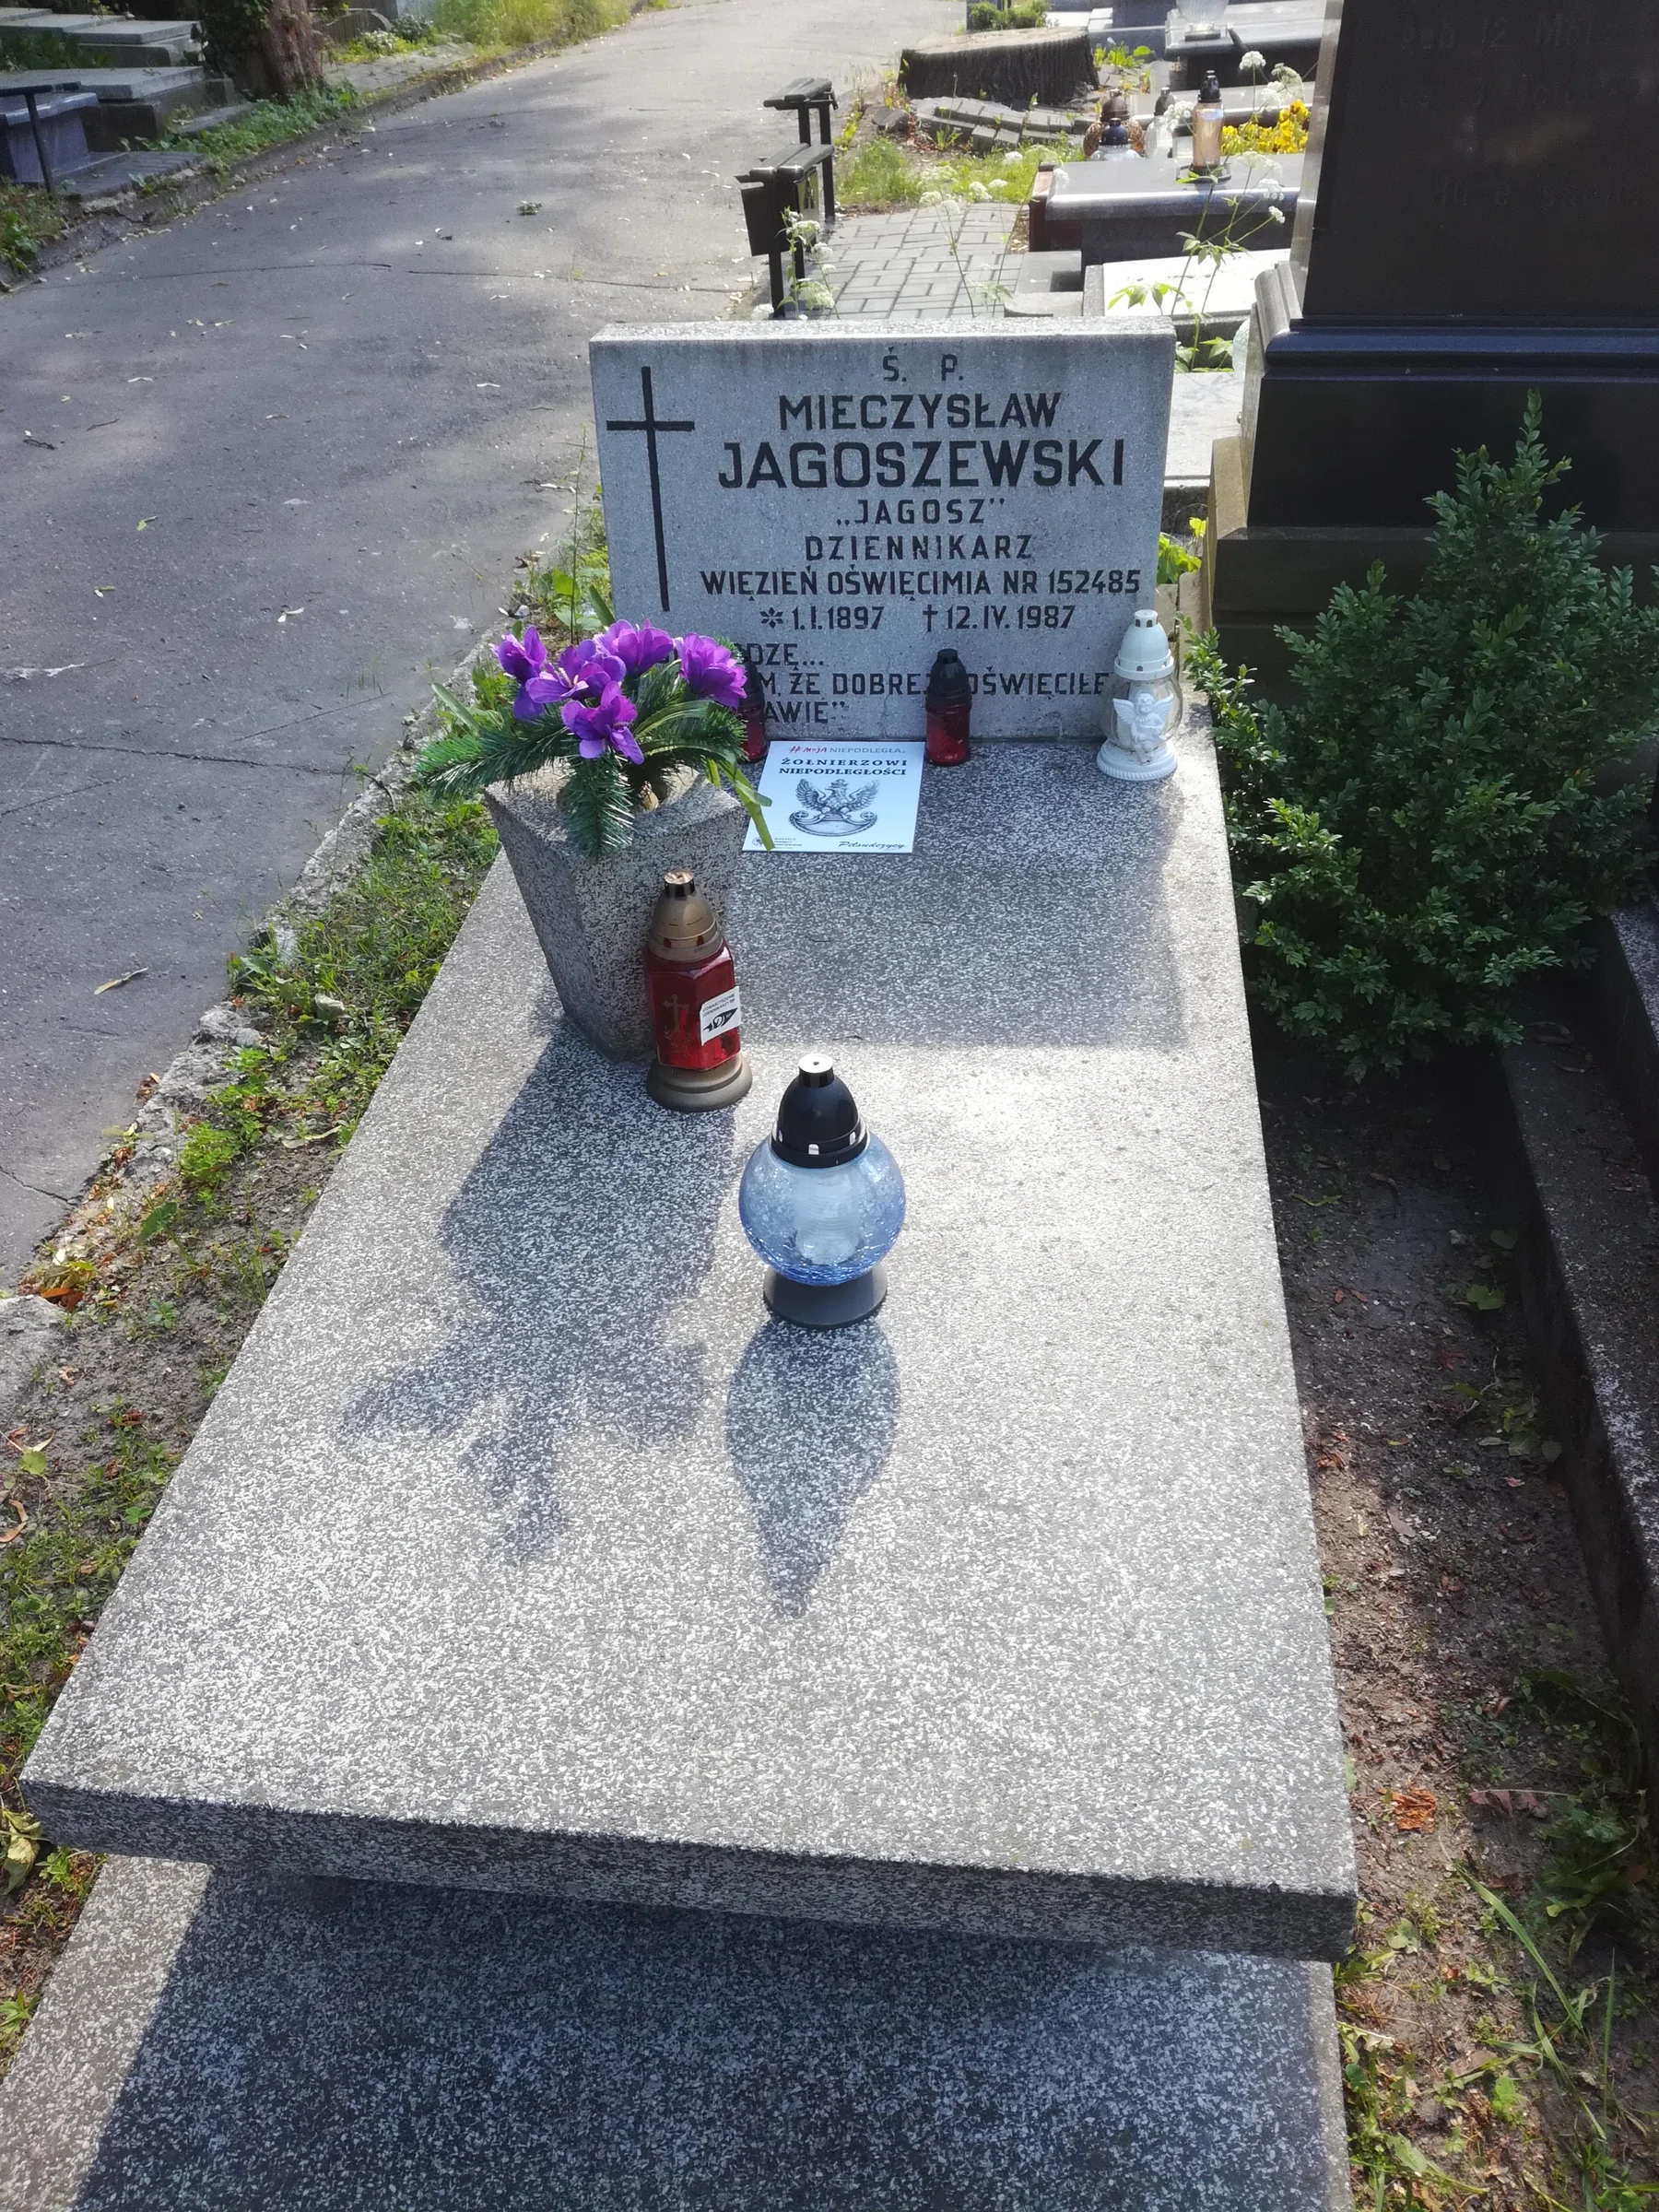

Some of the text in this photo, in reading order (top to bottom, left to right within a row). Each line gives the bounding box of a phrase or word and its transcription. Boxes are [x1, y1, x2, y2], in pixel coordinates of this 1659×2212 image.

[882, 347, 964, 382] Ś. P.
[779, 392, 1061, 431] MIECZYSŁAW
[717, 438, 1124, 489] JAGOSZEWSKI
[805, 534, 1032, 561] DZIENNIKARZ
[1004, 570, 1038, 595] NR
[1048, 569, 1141, 594] 152485
[779, 767, 907, 776] NIEPODLEGŁOŚCI
[781, 758, 908, 767] ŻOŁNIERZOWI
